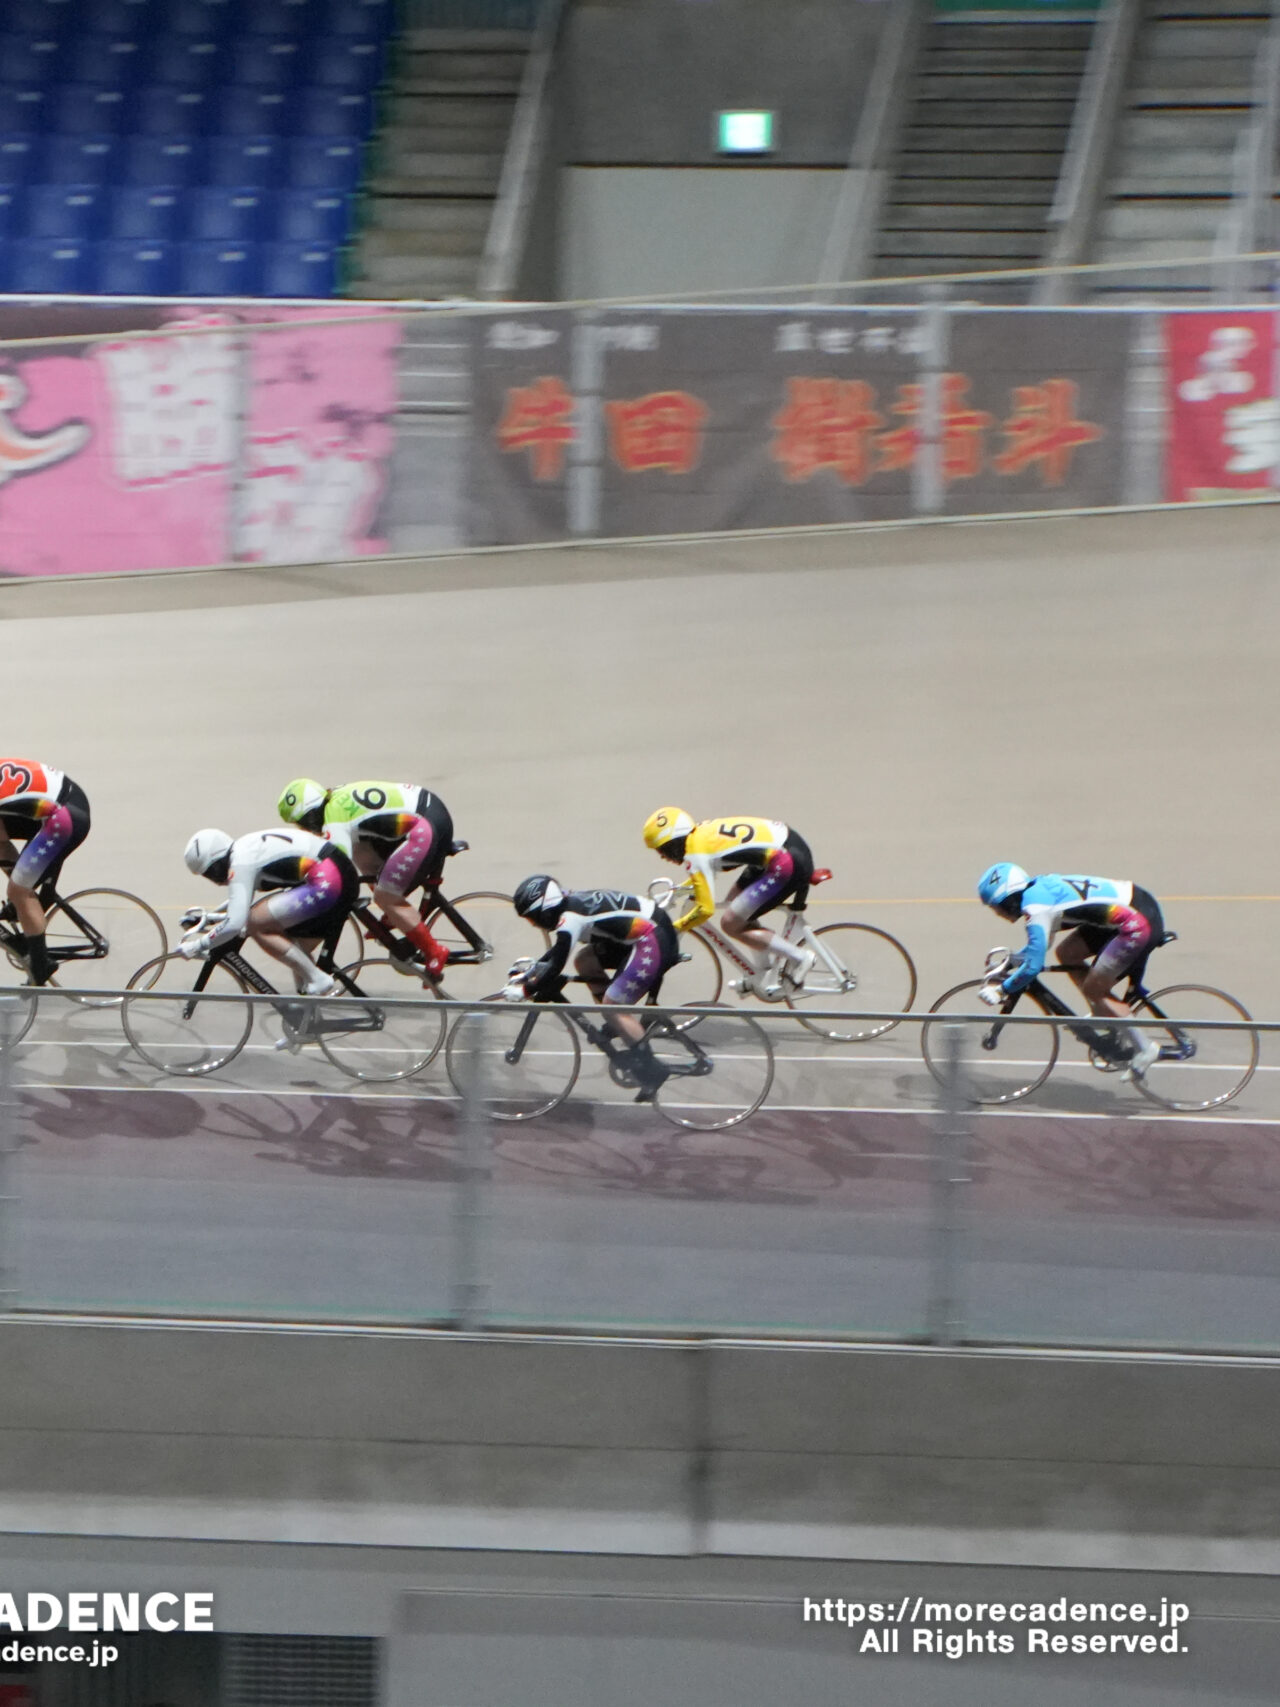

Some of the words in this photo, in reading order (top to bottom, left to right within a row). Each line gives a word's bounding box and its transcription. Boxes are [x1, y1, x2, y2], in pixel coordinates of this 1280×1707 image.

[285, 790, 297, 806] 6
[352, 787, 387, 810] 6
[655, 812, 668, 828] 5
[718, 823, 755, 844] 5
[989, 869, 1001, 885] 4
[1061, 878, 1099, 901] 4
